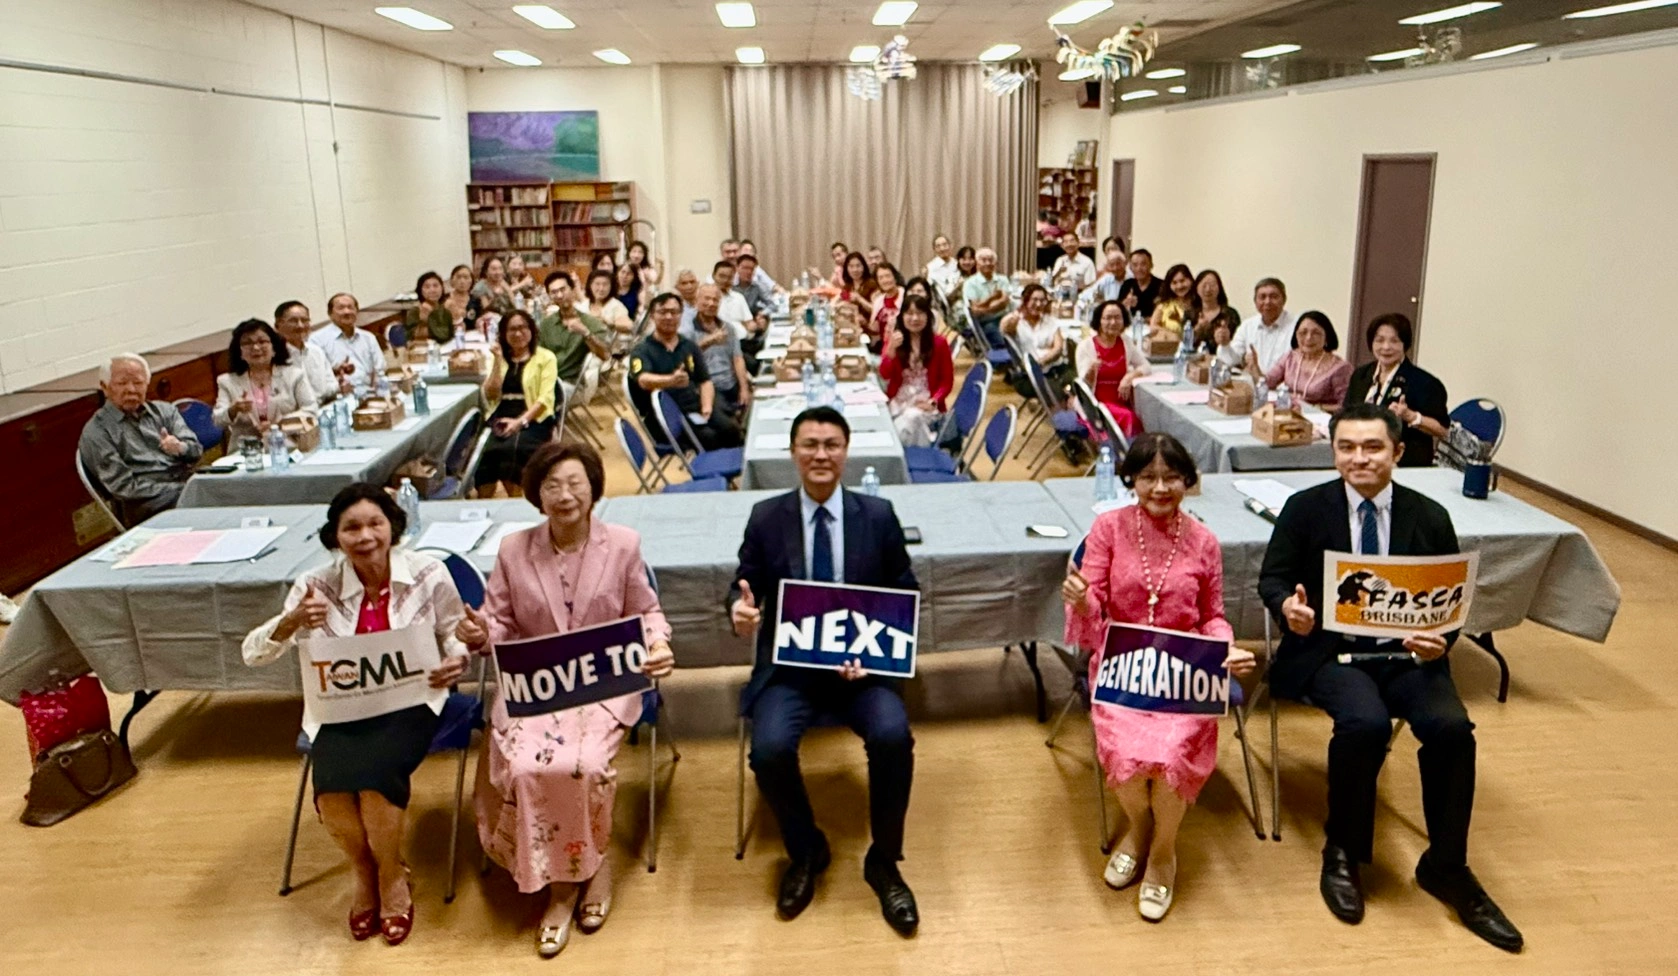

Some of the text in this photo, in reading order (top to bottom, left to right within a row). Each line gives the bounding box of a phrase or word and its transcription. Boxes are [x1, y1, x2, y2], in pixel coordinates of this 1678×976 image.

[1361, 609, 1448, 625] BRISBANE
[1369, 586, 1464, 610] FASCA
[778, 608, 914, 660] NEXT
[501, 642, 649, 704] MOVE TO
[1097, 646, 1228, 703] GENERATION
